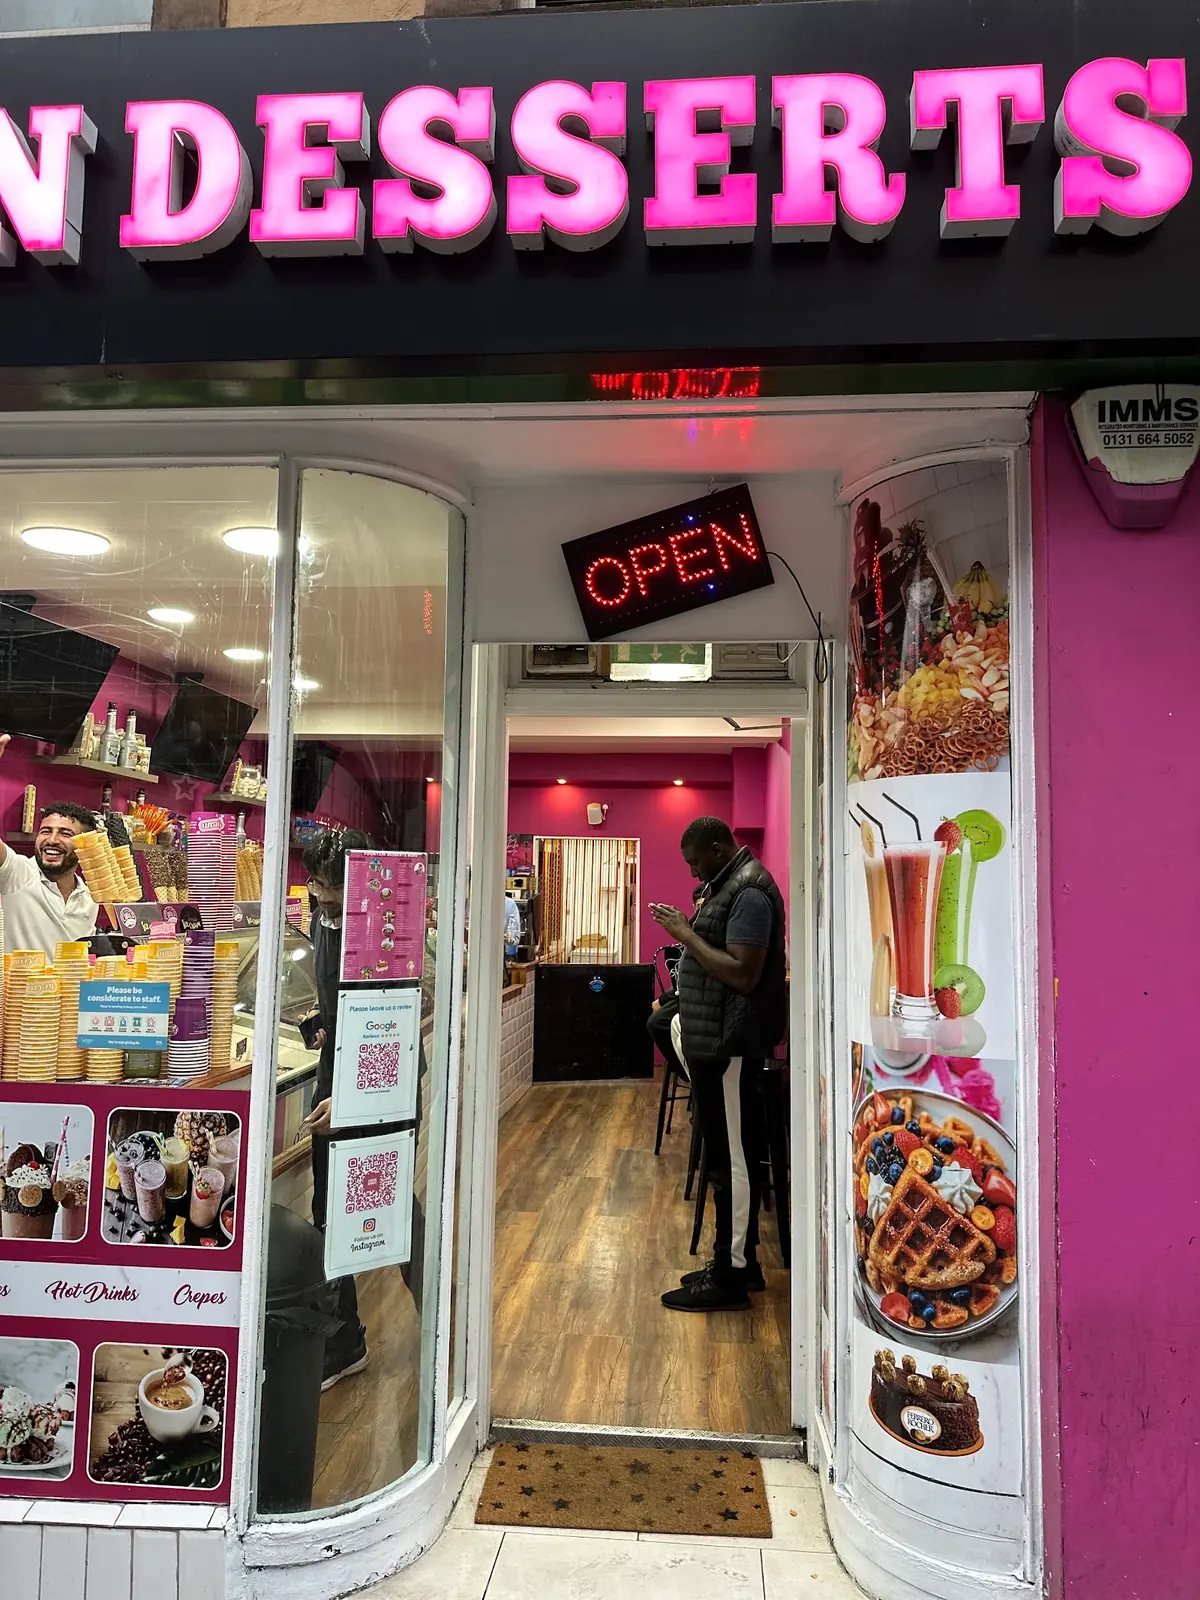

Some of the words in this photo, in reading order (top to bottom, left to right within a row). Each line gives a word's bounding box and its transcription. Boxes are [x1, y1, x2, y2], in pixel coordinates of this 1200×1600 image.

[119, 57, 1194, 262] DESSERTS
[1098, 397, 1199, 423] IMMS
[1103, 433, 1132, 446] 0131
[1137, 433, 1160, 445] 664
[1164, 432, 1194, 444] 5052
[585, 511, 760, 606] OPEN
[107, 986, 132, 994] Please
[133, 986, 143, 994] be
[87, 994, 132, 1003] considerate
[142, 995, 161, 1003] staff.
[366, 1020, 397, 1032] Google
[350, 1239, 386, 1253] Instagram
[45, 1280, 83, 1300] Hot
[82, 1281, 140, 1304] Drinks
[173, 1284, 228, 1309] Crepes
[907, 1411, 934, 1425] FERRERO
[907, 1419, 935, 1433] ROCHER
